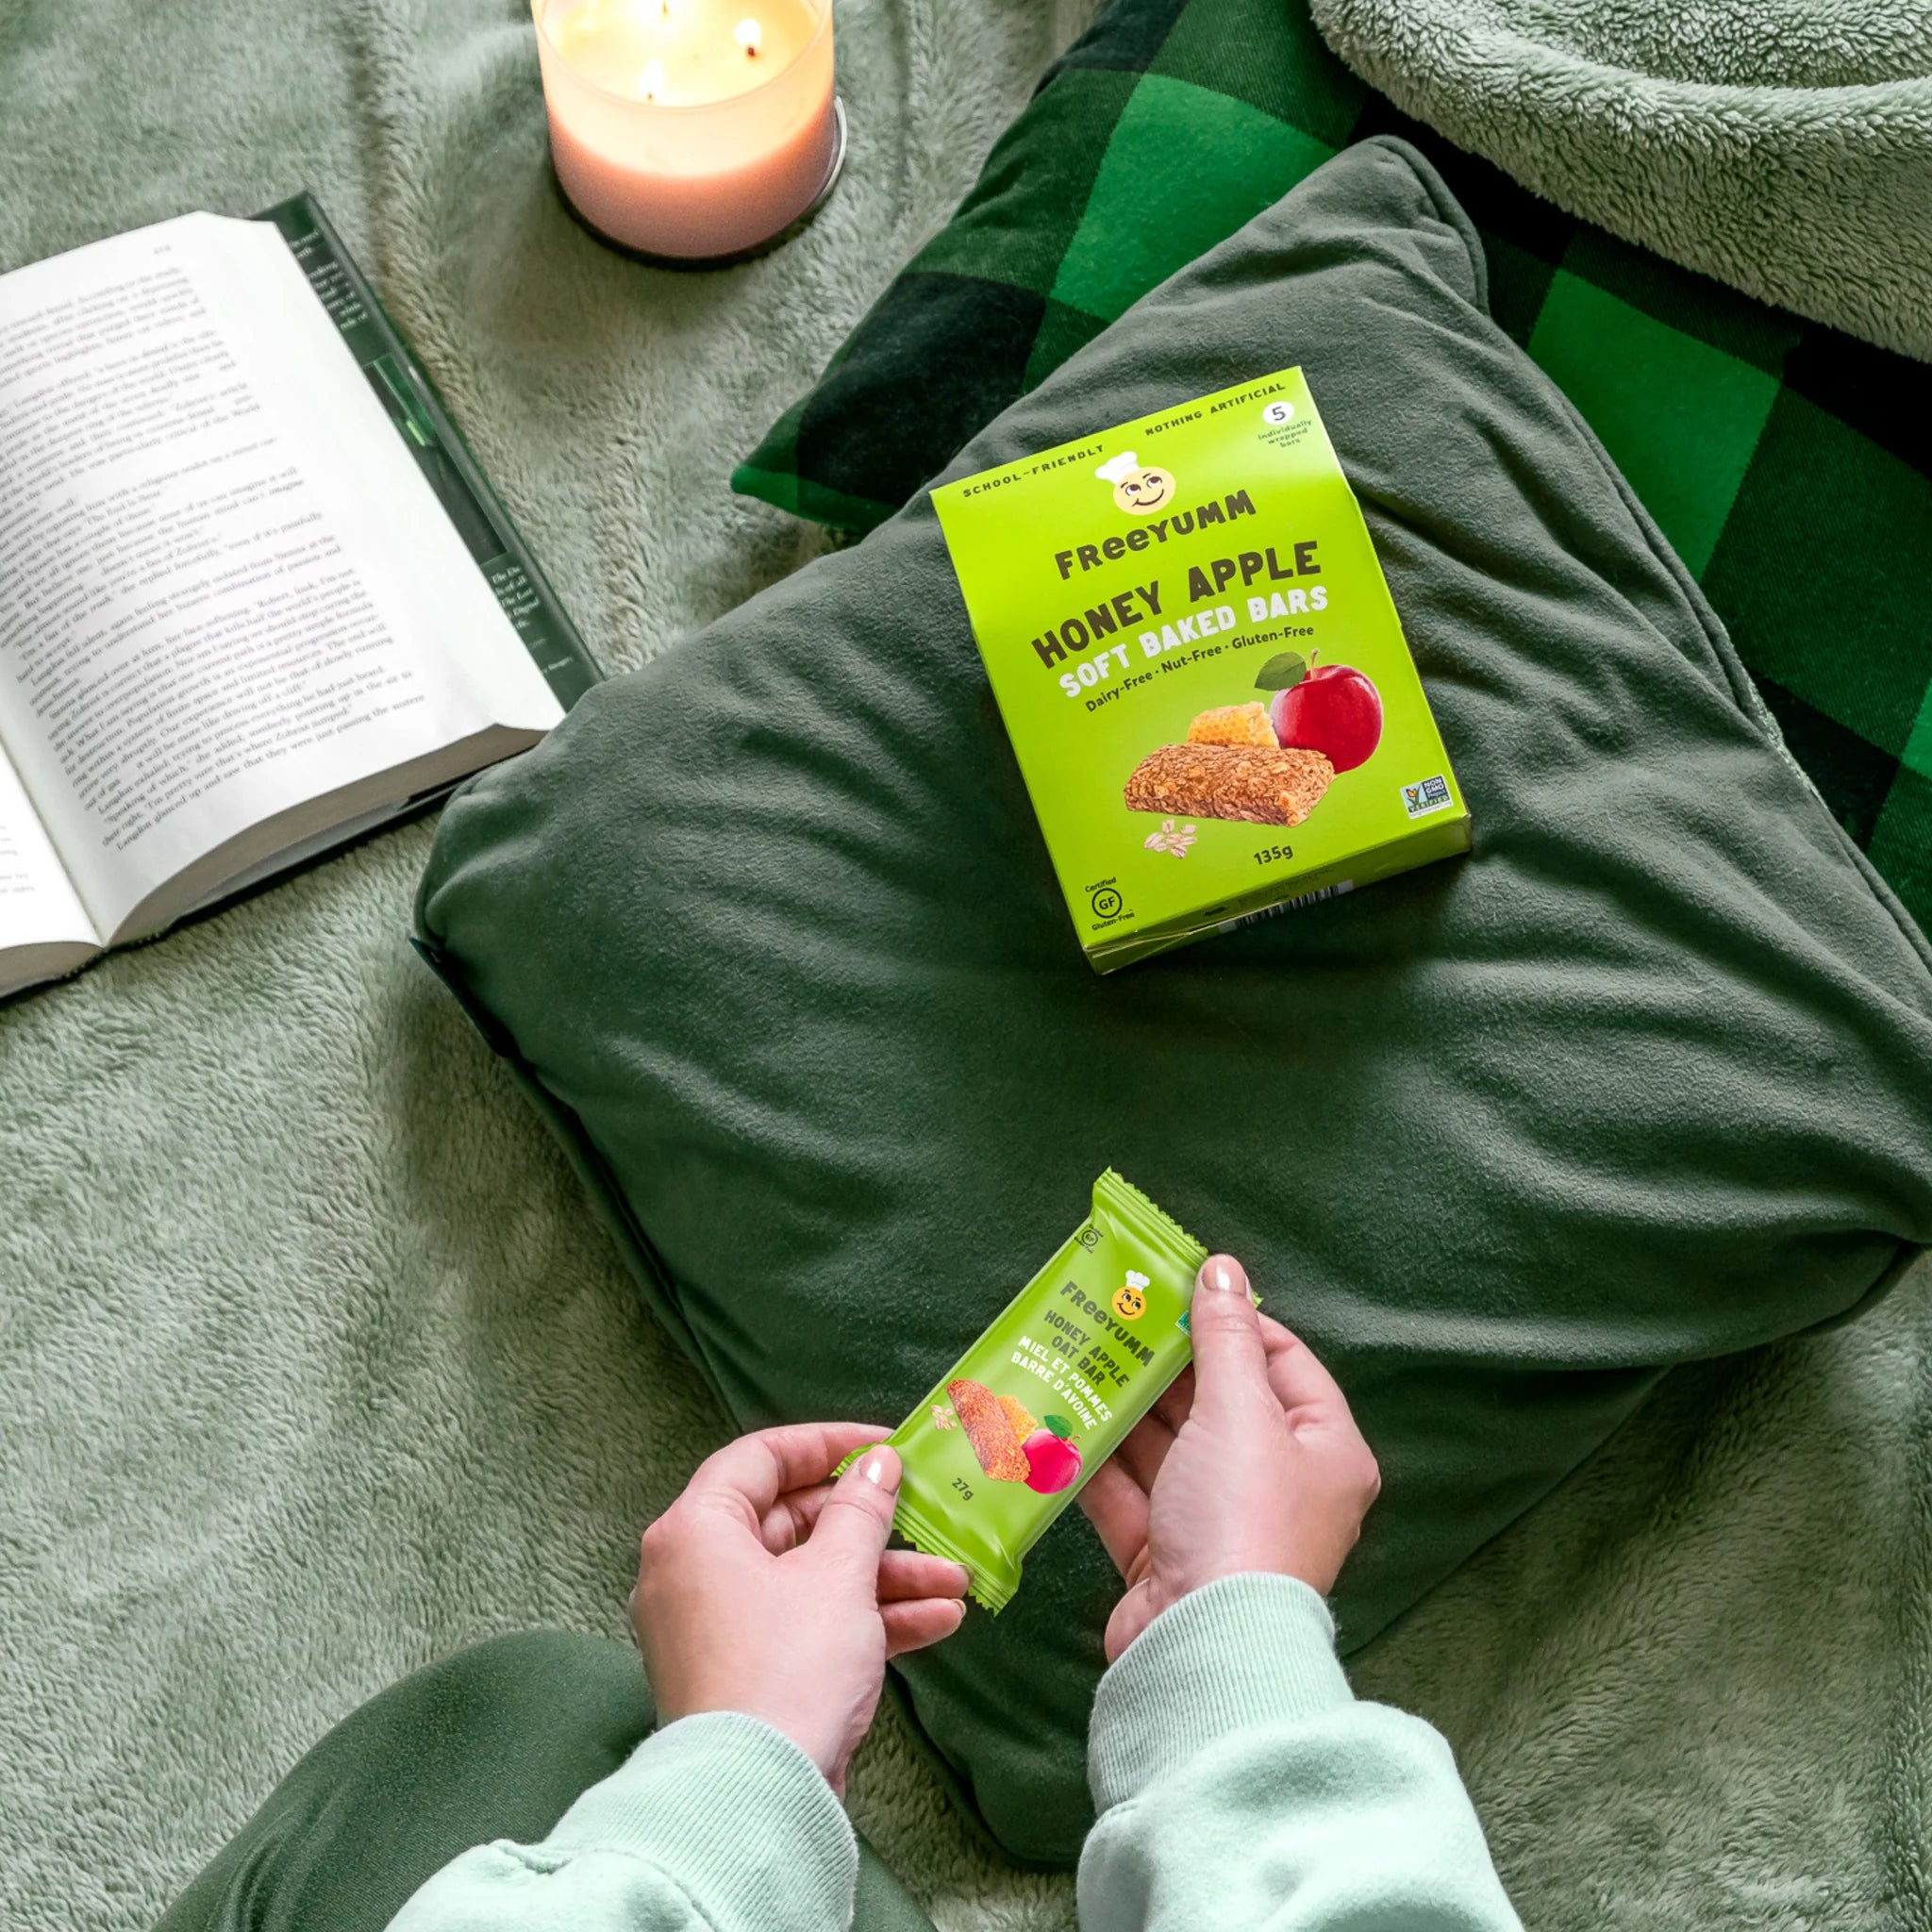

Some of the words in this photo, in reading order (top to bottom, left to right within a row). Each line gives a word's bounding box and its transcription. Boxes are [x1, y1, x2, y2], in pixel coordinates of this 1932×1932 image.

[1144, 410, 1203, 437] NOTHING
[1210, 382, 1286, 414] ARTIFICIAL
[1272, 406, 1286, 421] 5
[1257, 420, 1312, 440] individually
[1268, 427, 1308, 444] wrapped
[1280, 438, 1301, 448] bars
[962, 444, 1105, 498] SCHOOL-FRIENDLY
[1031, 580, 1163, 670] HONEY
[1187, 540, 1322, 603] APPLE
[1058, 643, 1131, 698] SOFT
[1138, 605, 1237, 658] BAKED
[1246, 585, 1328, 624] BARS
[1085, 671, 1153, 712] Dairy-Free
[1161, 644, 1222, 674] Nut-Free
[1231, 625, 1314, 651] Gluten-Free
[1424, 777, 1442, 788] NON
[1425, 783, 1444, 793] GMO
[1253, 844, 1293, 865] 135g
[1085, 875, 1117, 893] Certified
[1098, 896, 1116, 911] GF
[1091, 910, 1135, 931] Gluten-Free
[1043, 1309, 1091, 1346] HONEY
[1089, 1346, 1130, 1388] APPLE
[1011, 1351, 1054, 1383] BARRE
[1051, 1335, 1080, 1359] OAT
[1077, 1357, 1106, 1386] BAR
[1017, 1336, 1048, 1362] MIEL
[1050, 1357, 1071, 1374] ET
[1068, 1369, 1113, 1423] POMMES
[951, 1477, 974, 1502] 27g
